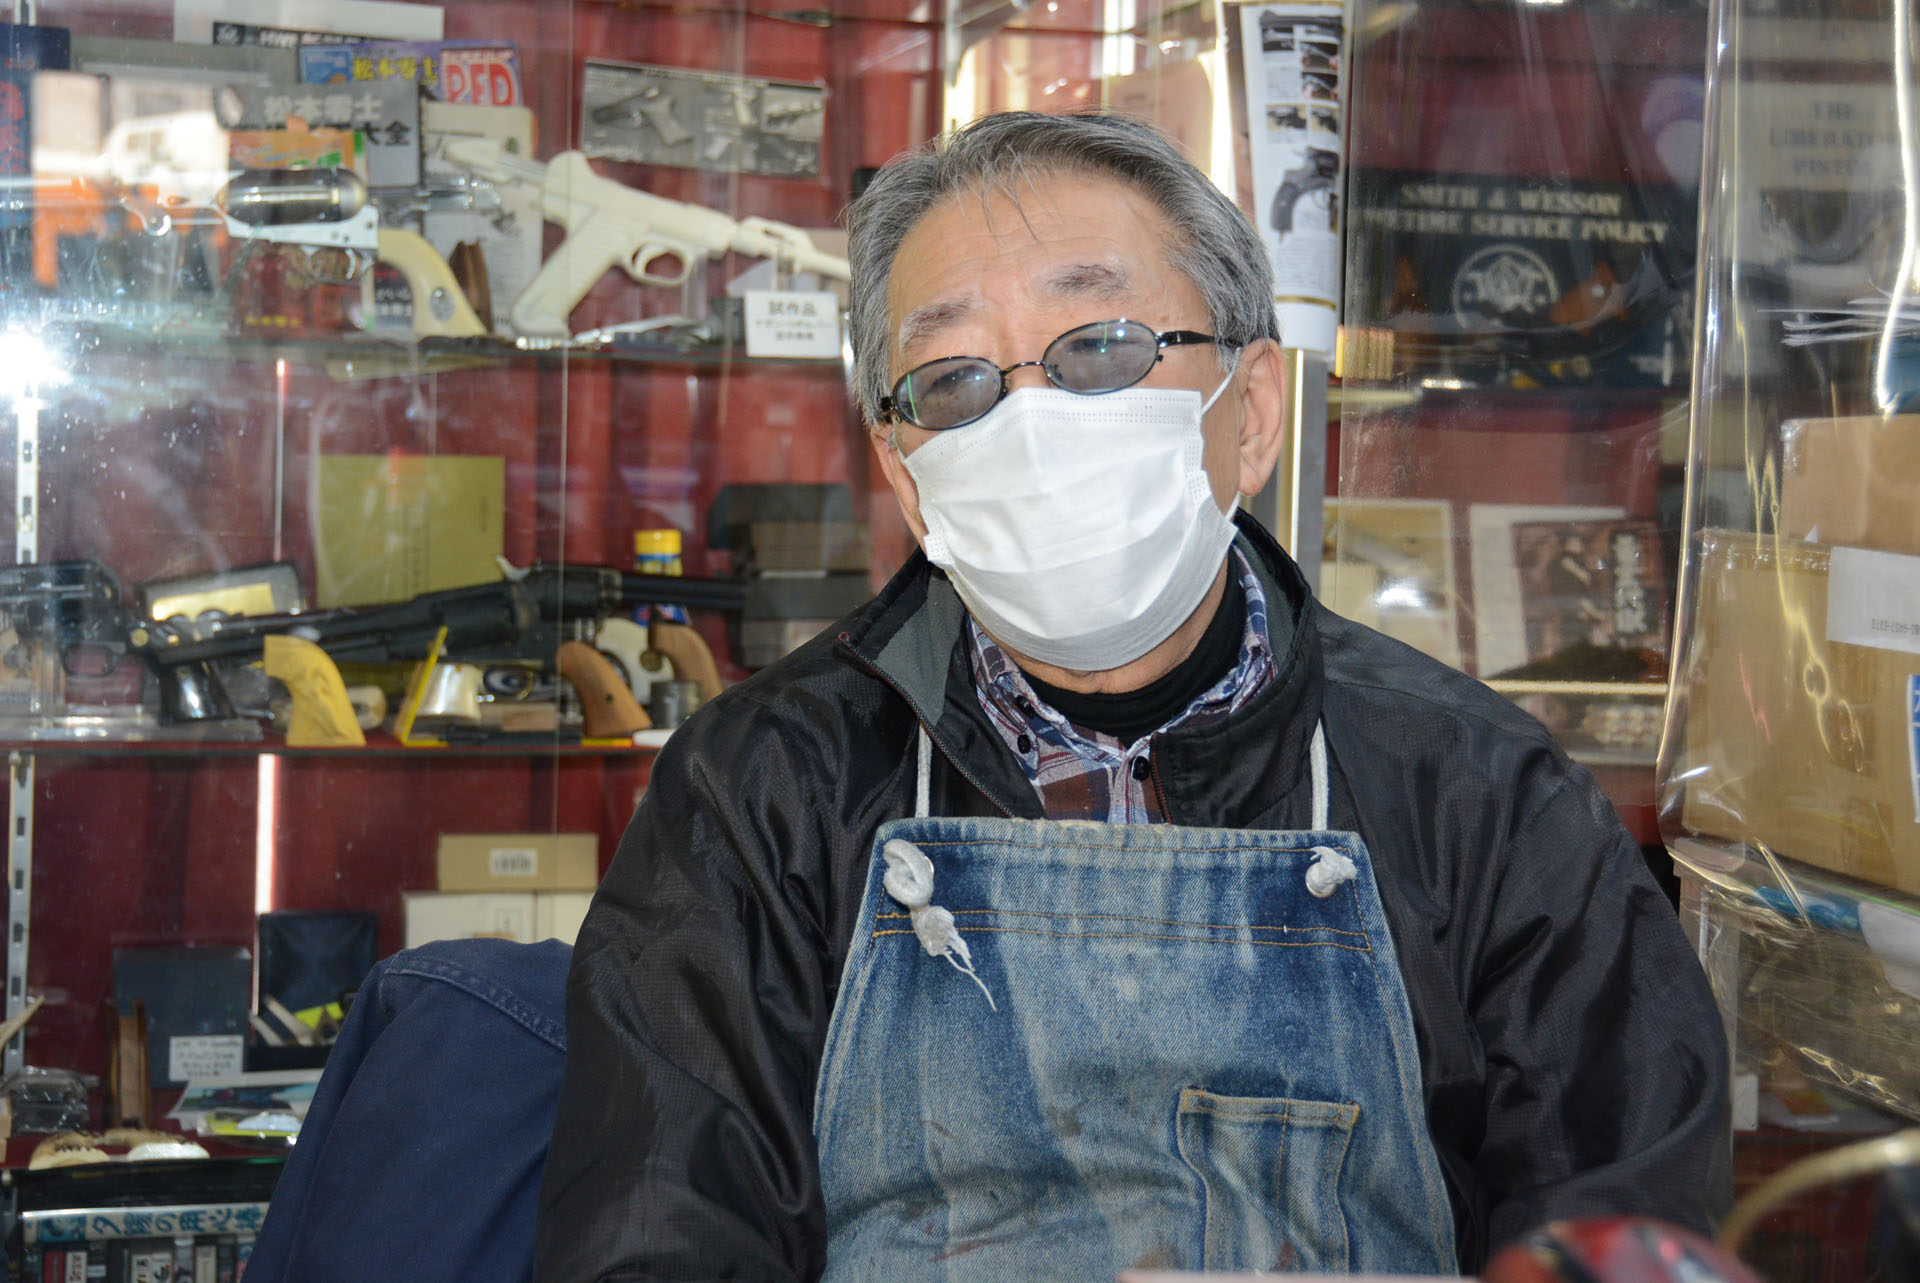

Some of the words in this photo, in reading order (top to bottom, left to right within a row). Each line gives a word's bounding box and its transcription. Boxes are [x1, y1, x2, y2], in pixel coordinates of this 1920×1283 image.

[264, 94, 385, 124] 松本零士
[1401, 184, 1479, 210] SMITH
[1487, 188, 1506, 210] &
[1519, 189, 1623, 216] WESSON
[1471, 212, 1572, 239] SERVICE
[1582, 217, 1670, 244] POLICY
